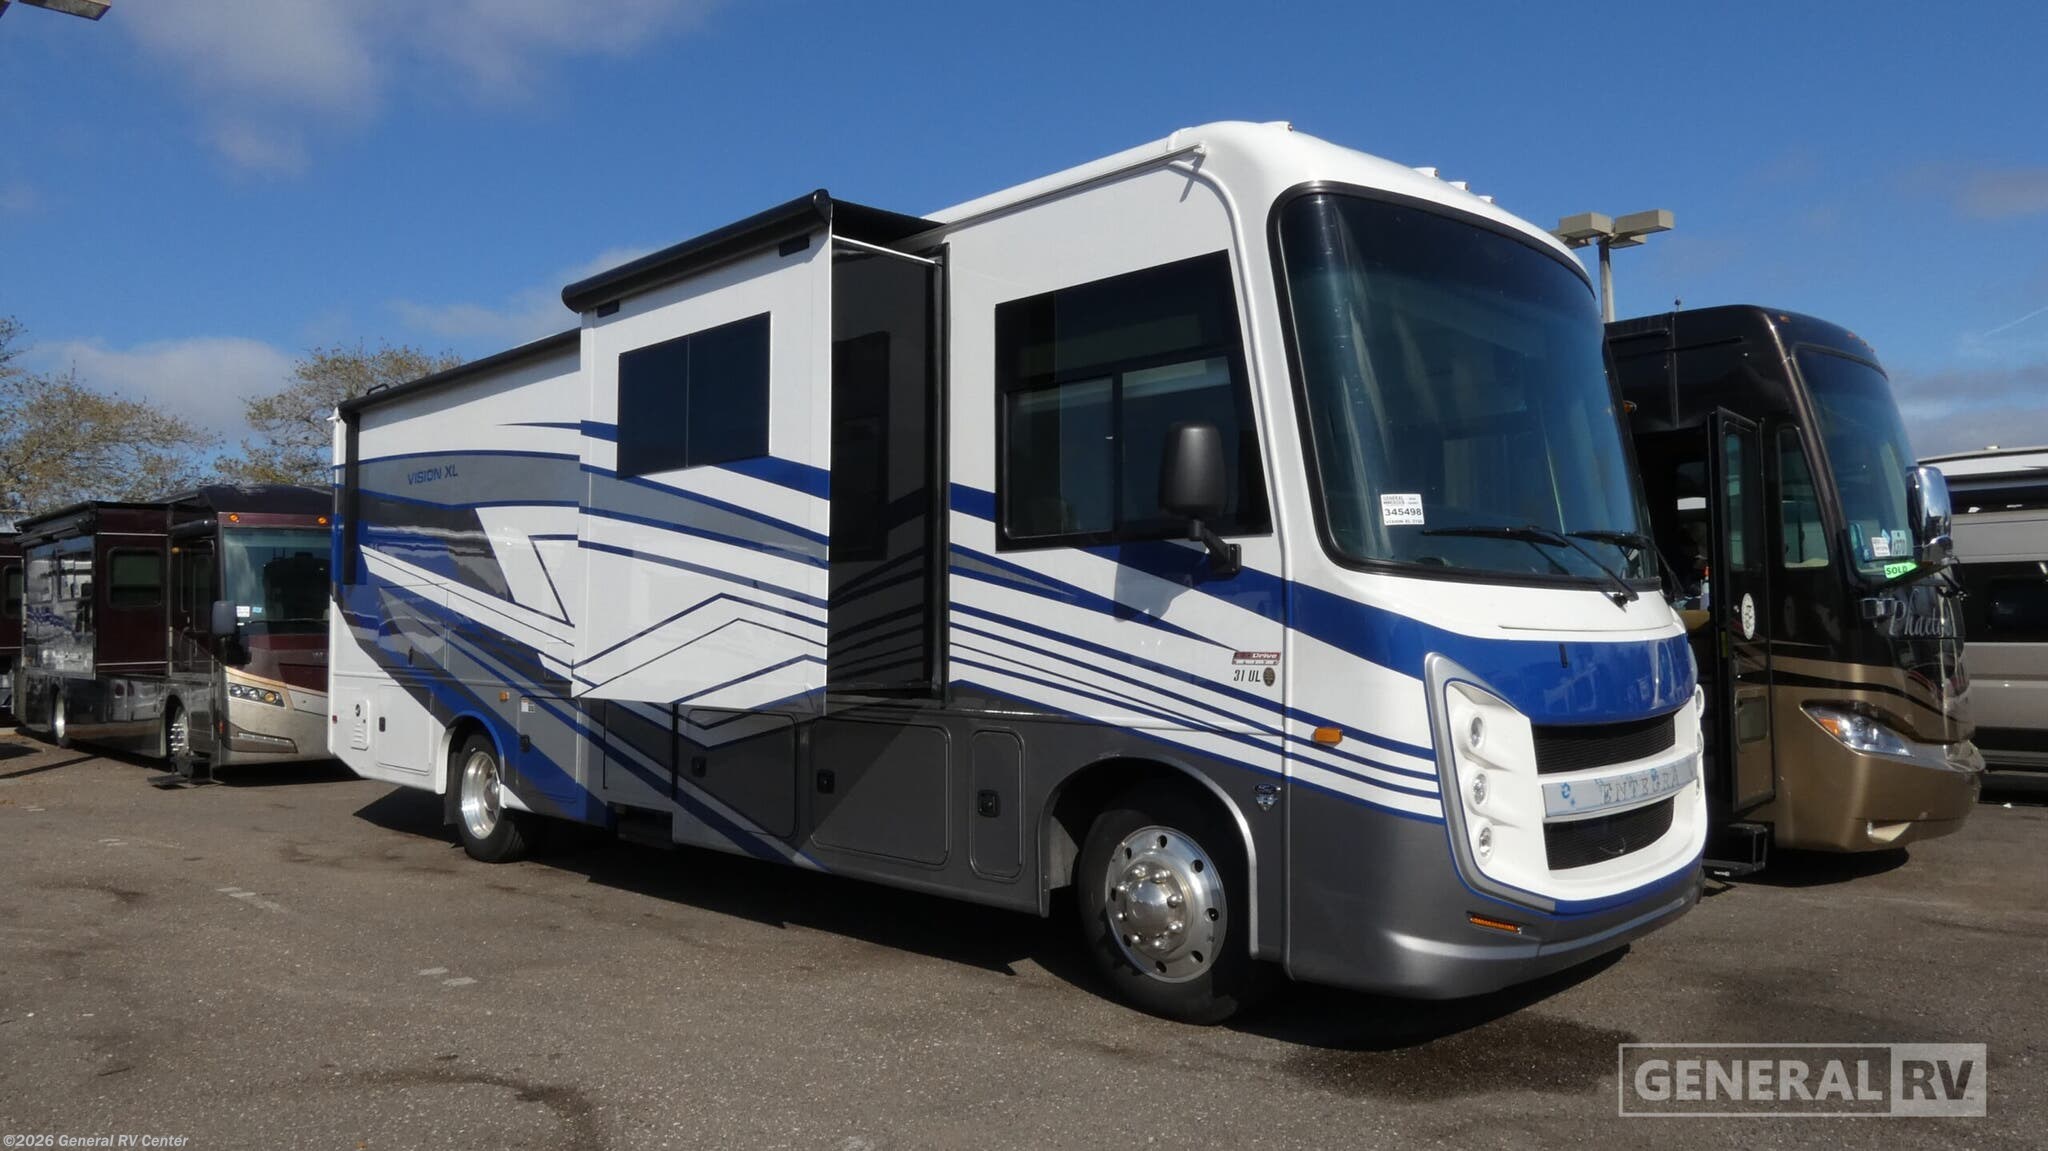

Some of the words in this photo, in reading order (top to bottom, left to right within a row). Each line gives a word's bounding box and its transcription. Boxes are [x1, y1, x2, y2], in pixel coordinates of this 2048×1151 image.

[408, 466, 442, 485] VISION
[444, 464, 459, 479] XL
[1384, 508, 1422, 516] 345498
[1886, 566, 1908, 576] SOLD
[1233, 669, 1245, 682] 31
[1248, 669, 1261, 682] UL
[1600, 764, 1681, 804] ENTEGRA
